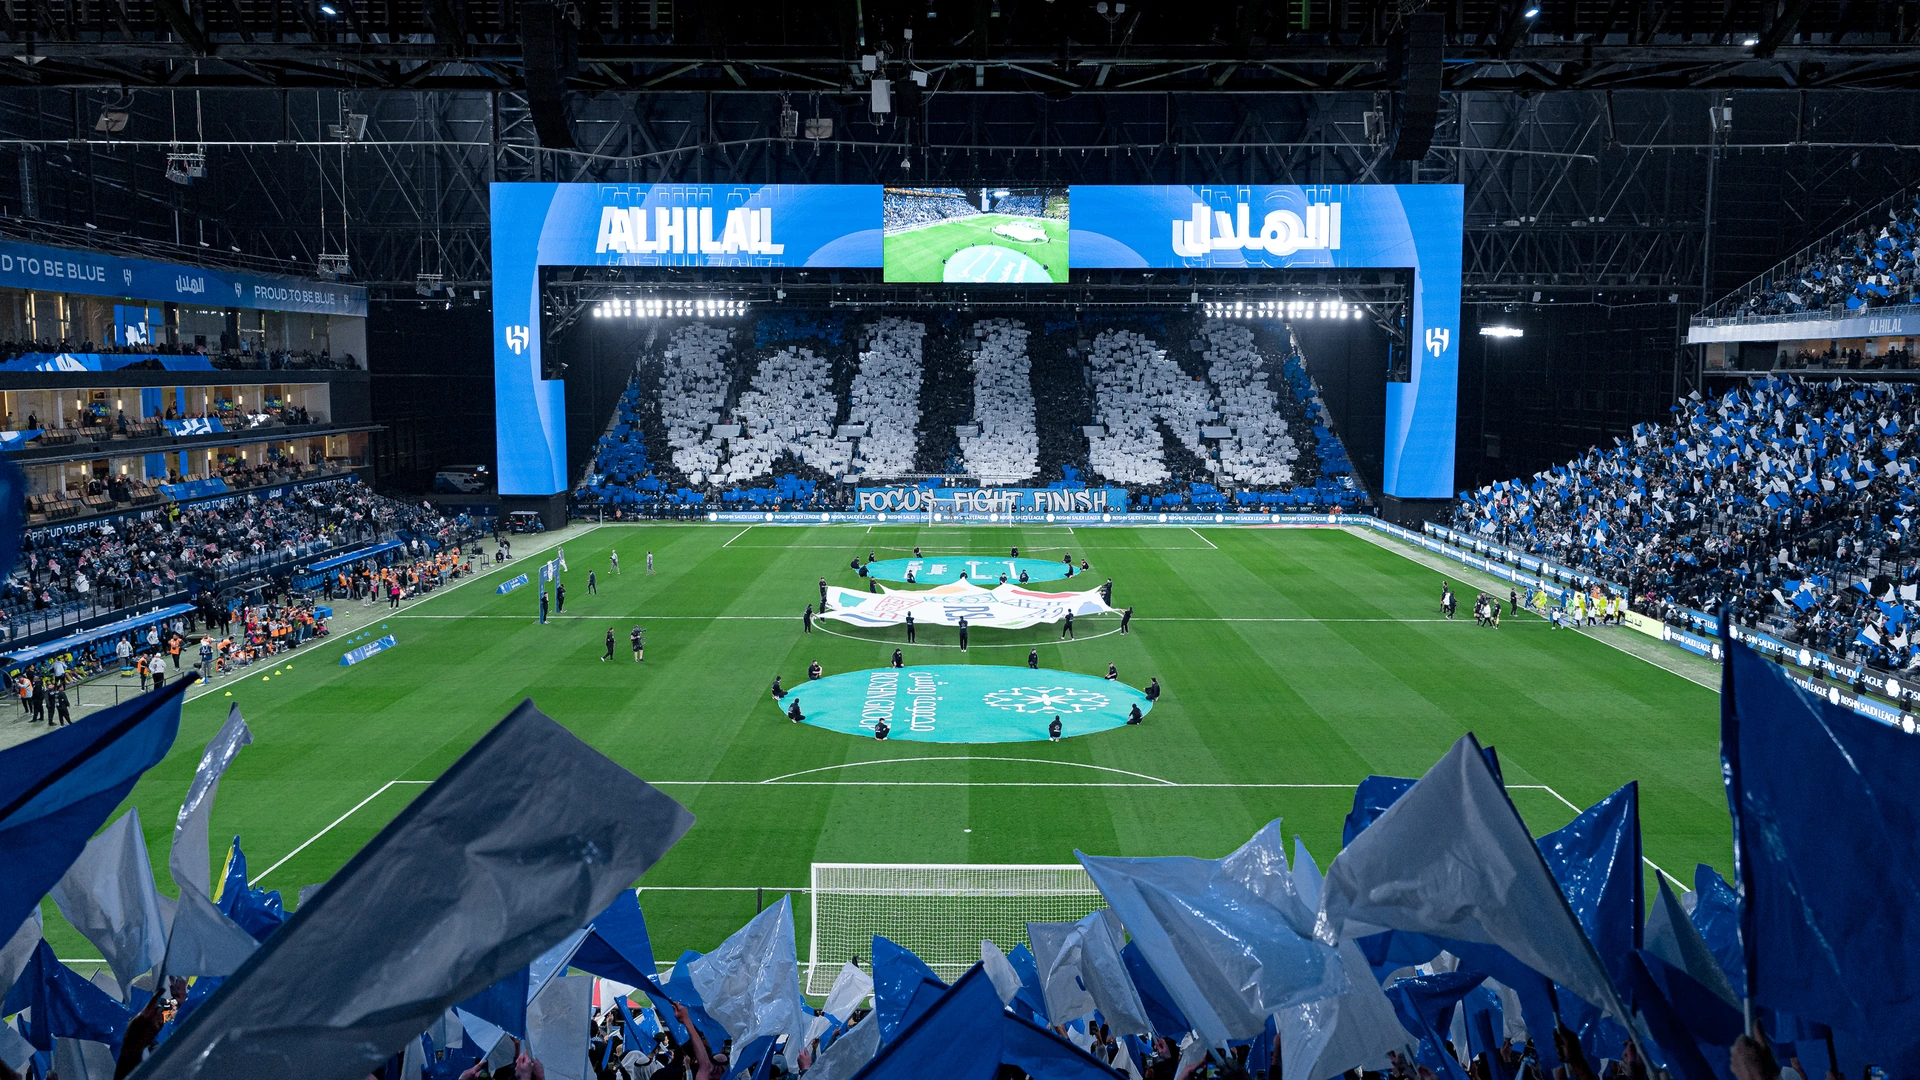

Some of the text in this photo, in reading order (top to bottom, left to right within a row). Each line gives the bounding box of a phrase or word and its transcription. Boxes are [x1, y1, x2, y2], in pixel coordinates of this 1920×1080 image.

[596, 206, 785, 254] ALHILAL
[1172, 202, 1341, 257] الهلال
[16, 256, 40, 275] TO
[44, 260, 64, 278] BE
[67, 263, 106, 282] BLUE
[254, 285, 335, 305] PROUD TO BE BLUE
[1868, 318, 1902, 334] ALHILAL
[31, 526, 63, 541] PRUD
[1695, 640, 1711, 653] LEAGUE
[1739, 631, 1758, 645] RSHN
[1758, 638, 1775, 650] SAUDI
[1835, 666, 1856, 679] SAUDI
[866, 672, 900, 699] ROSHN
[1807, 682, 1828, 698] LEAGUE
[1860, 702, 1878, 718] SAUDI
[1877, 709, 1901, 726] LEAGUE
